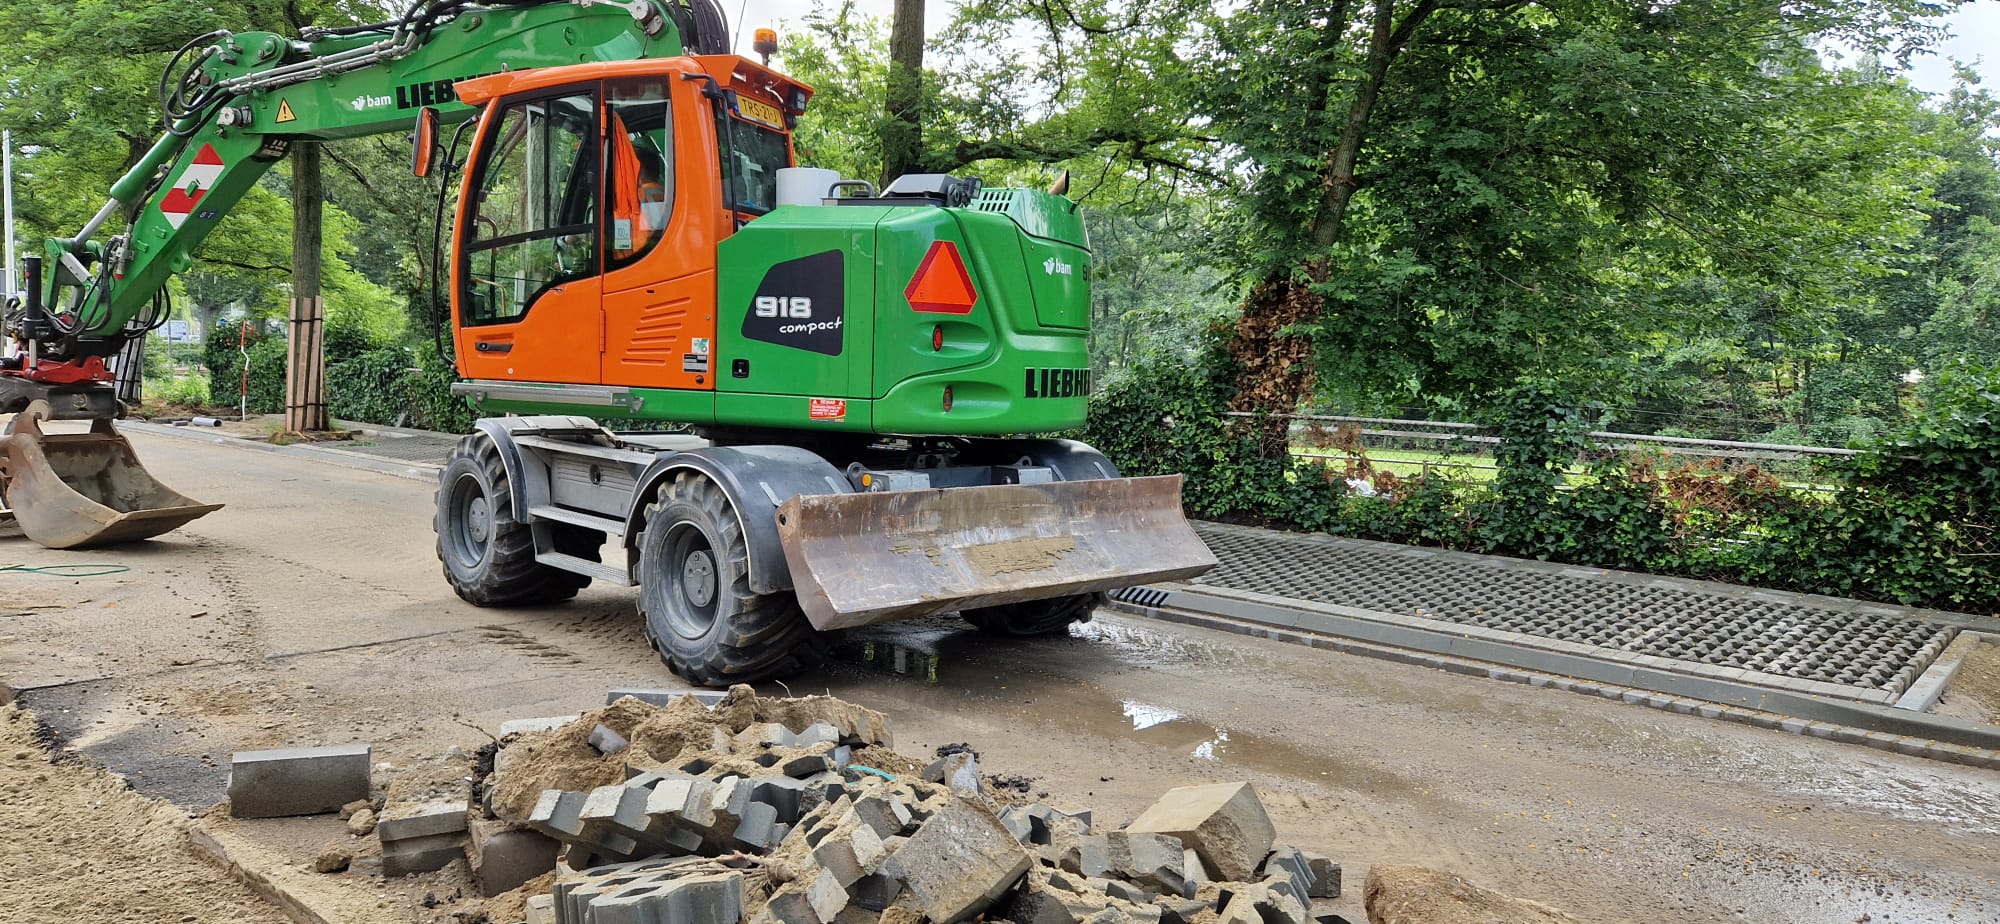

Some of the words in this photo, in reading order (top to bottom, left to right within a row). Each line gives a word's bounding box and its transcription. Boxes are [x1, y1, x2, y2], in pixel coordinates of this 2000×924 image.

[367, 95, 391, 107] bam
[1055, 258, 1072, 275] bam
[756, 296, 811, 318] 918
[779, 316, 842, 334] compact
[1025, 368, 1091, 398] LIEBHE
